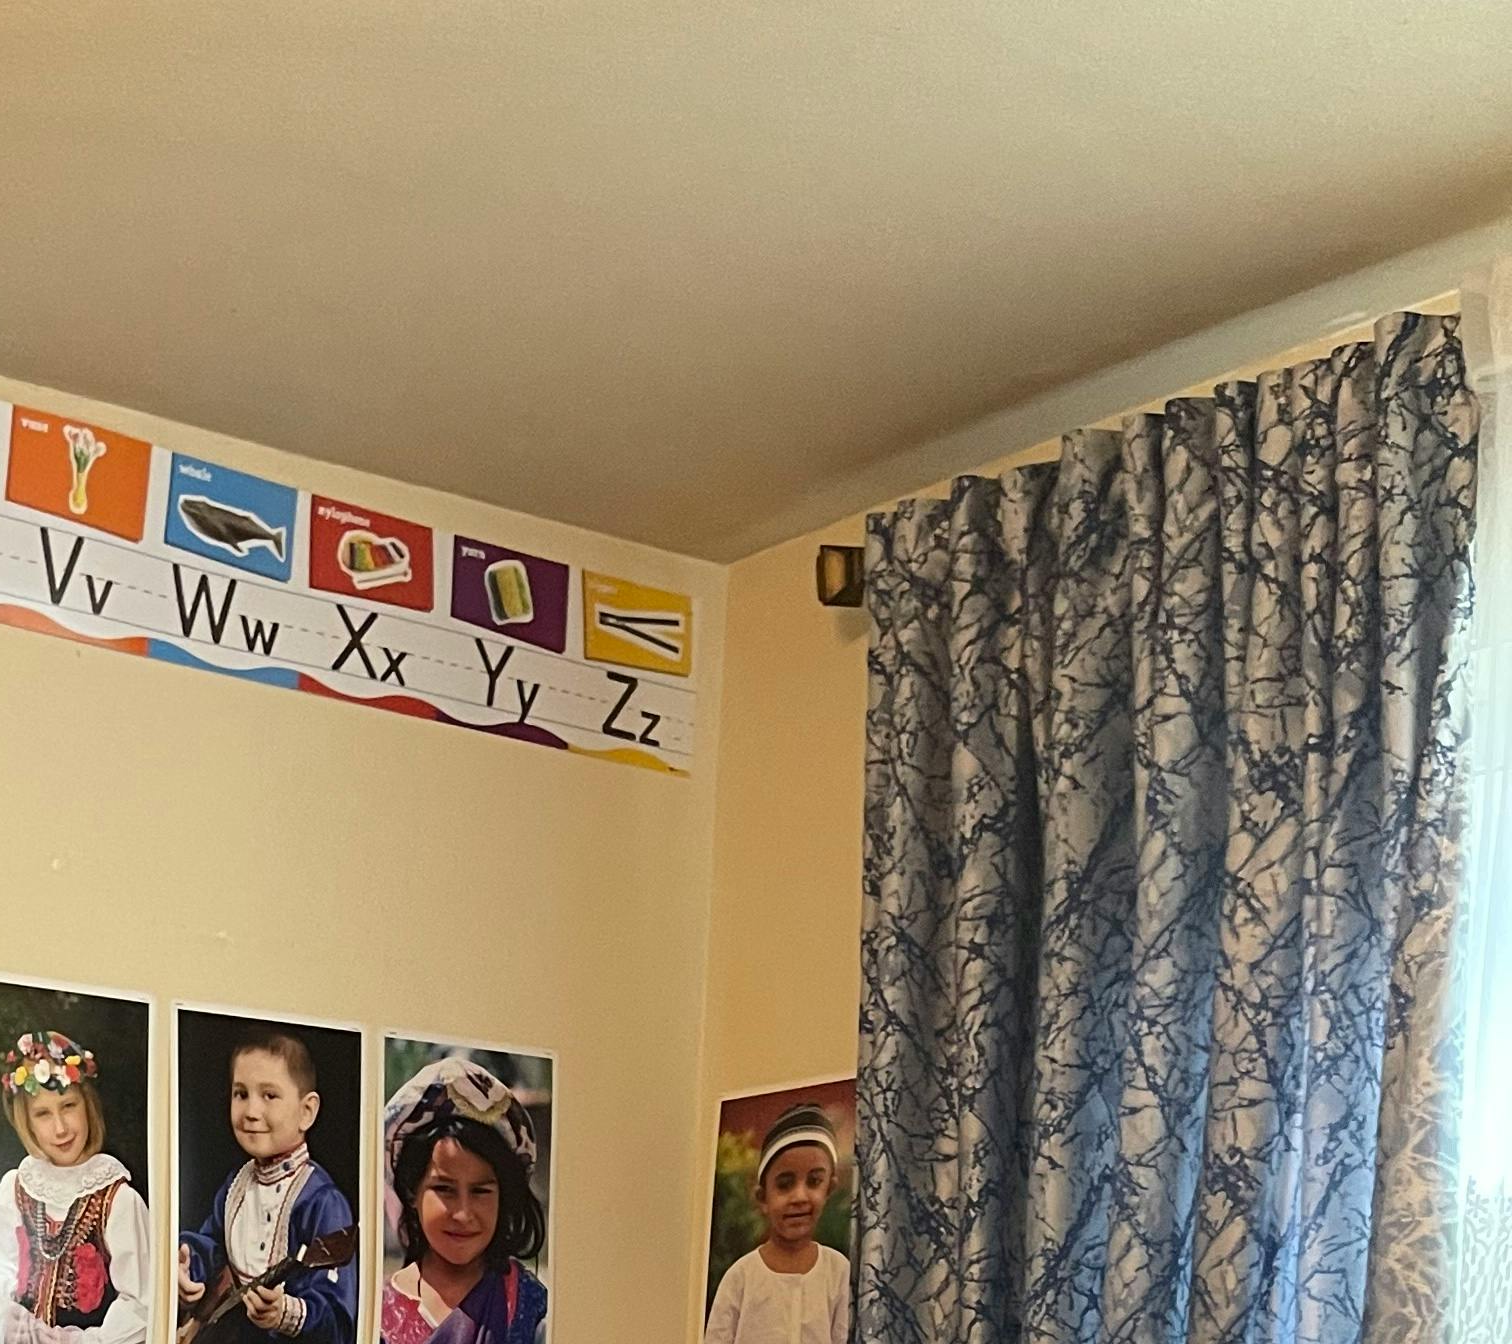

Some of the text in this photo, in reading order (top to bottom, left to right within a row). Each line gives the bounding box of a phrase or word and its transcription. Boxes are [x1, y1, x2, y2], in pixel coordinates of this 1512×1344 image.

[40, 527, 113, 615] Vv
[173, 563, 279, 656] Ww
[331, 604, 407, 686] Xx
[476, 638, 540, 723] Yy
[602, 671, 660, 747] Zz
